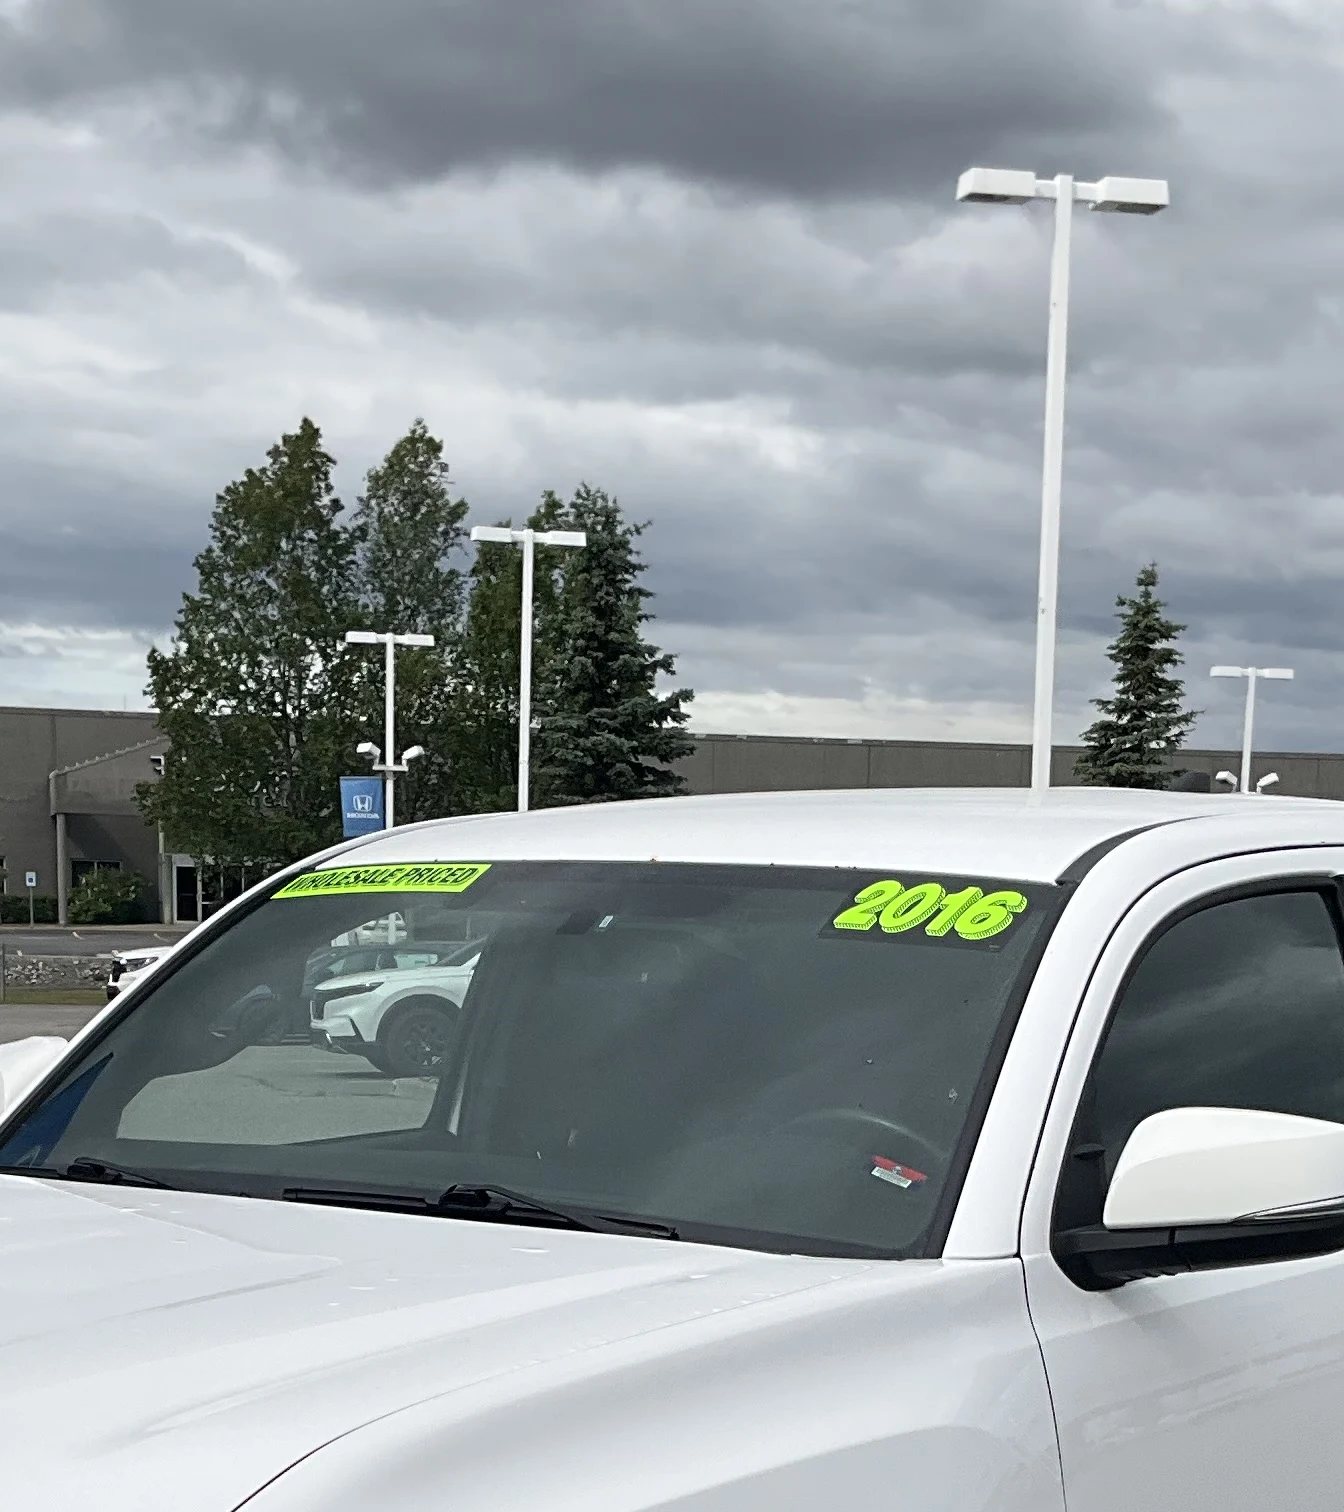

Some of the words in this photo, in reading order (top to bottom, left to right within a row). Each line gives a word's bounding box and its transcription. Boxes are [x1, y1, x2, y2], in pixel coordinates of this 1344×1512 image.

[283, 868, 403, 893] WHOLESALE
[392, 867, 479, 887] PRICED
[833, 879, 1029, 941] 2016
